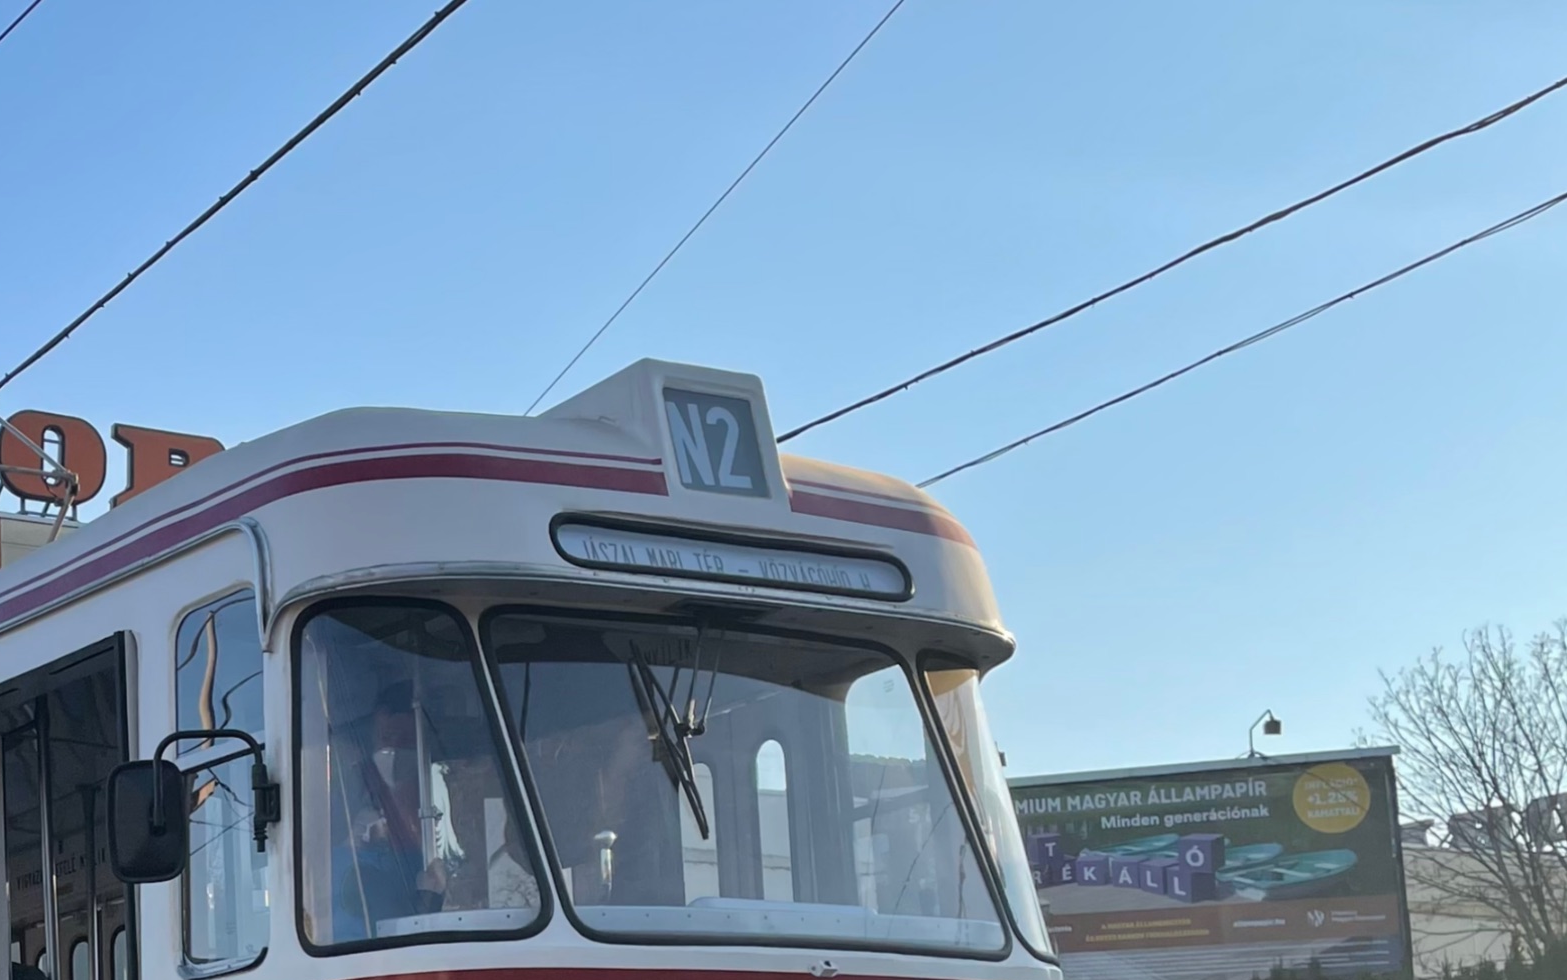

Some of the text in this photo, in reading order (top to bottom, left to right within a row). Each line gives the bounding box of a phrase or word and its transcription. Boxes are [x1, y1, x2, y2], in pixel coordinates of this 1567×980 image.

[665, 401, 753, 488] N2
[693, 550, 725, 573] TÉR
[1067, 791, 1142, 811] MAGYAR
[1147, 776, 1267, 805] ÁLLAMPAPÍR
[1101, 804, 1269, 829] Minden generációnak
